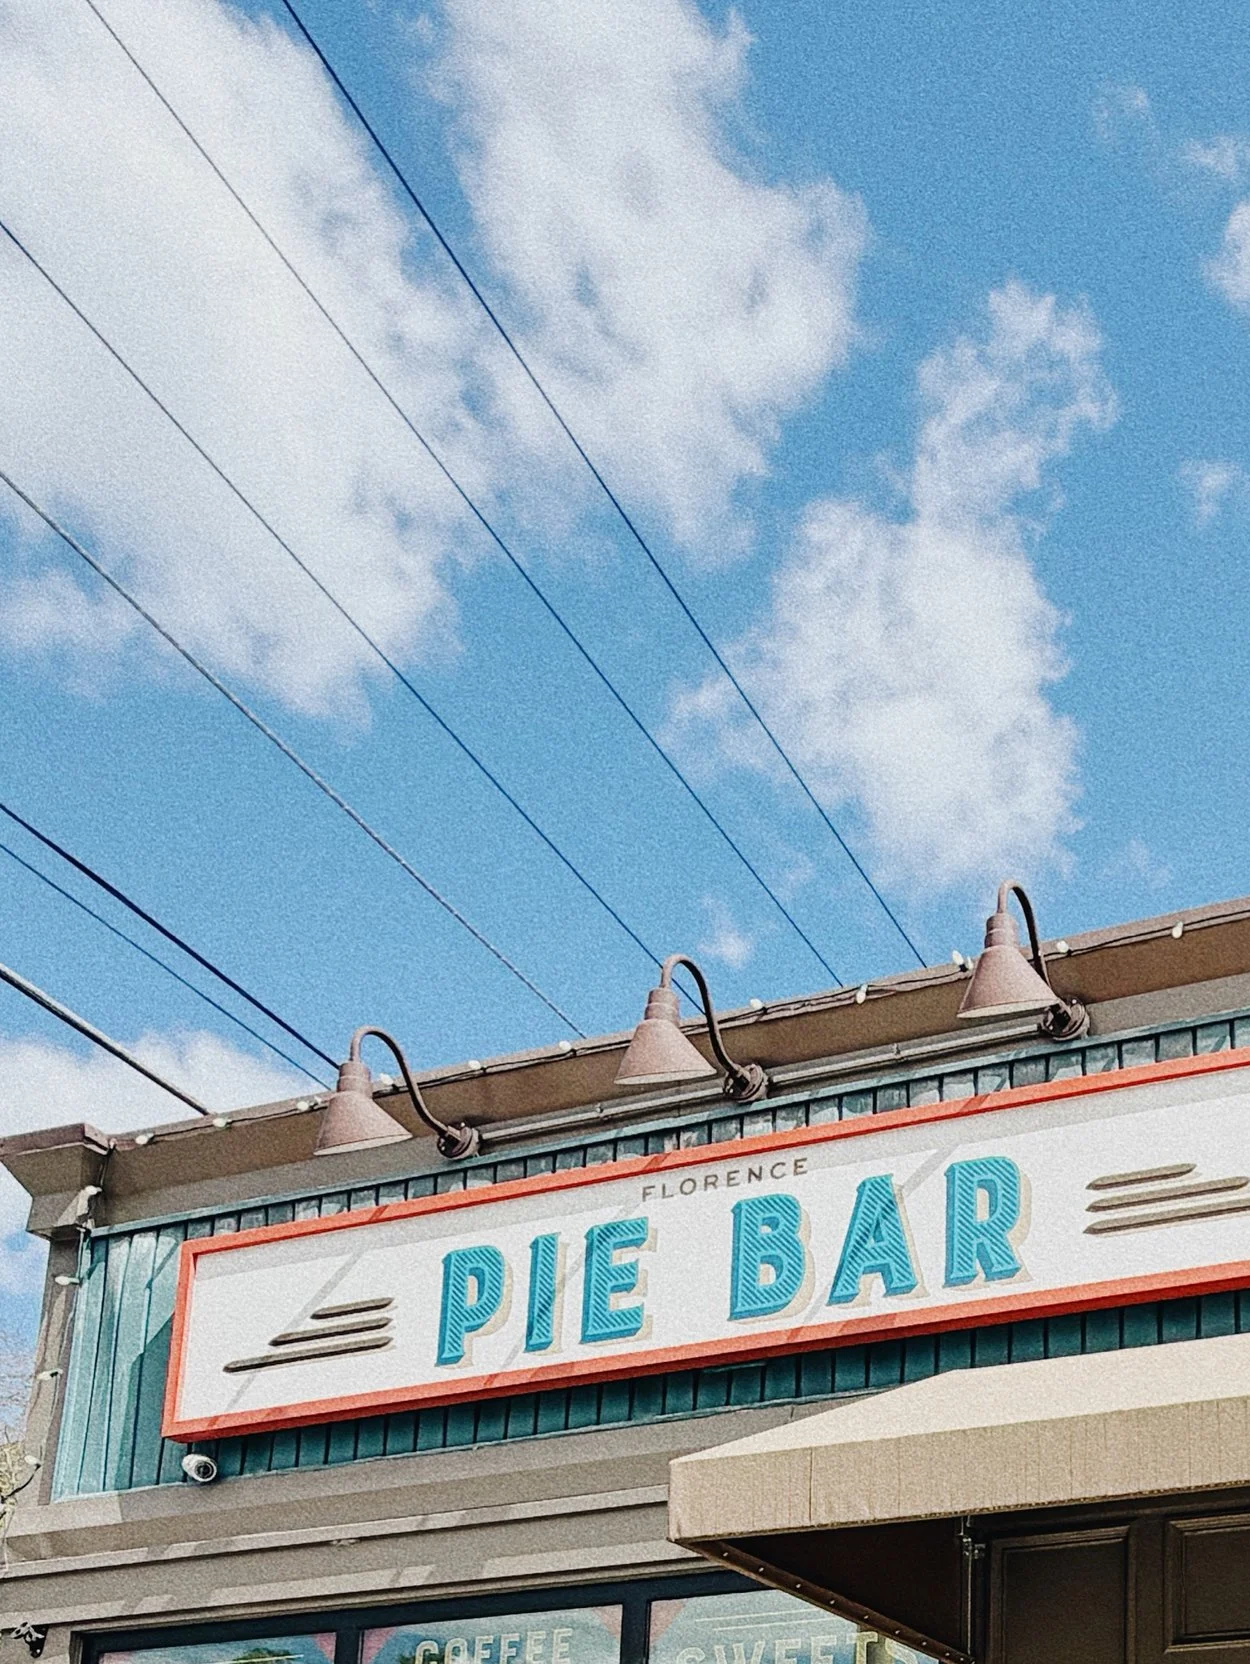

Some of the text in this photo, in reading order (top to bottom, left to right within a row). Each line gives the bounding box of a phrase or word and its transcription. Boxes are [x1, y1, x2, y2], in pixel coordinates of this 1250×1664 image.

[641, 1157, 808, 1202] FLORENCE
[435, 1155, 1032, 1369] PIE BAR
